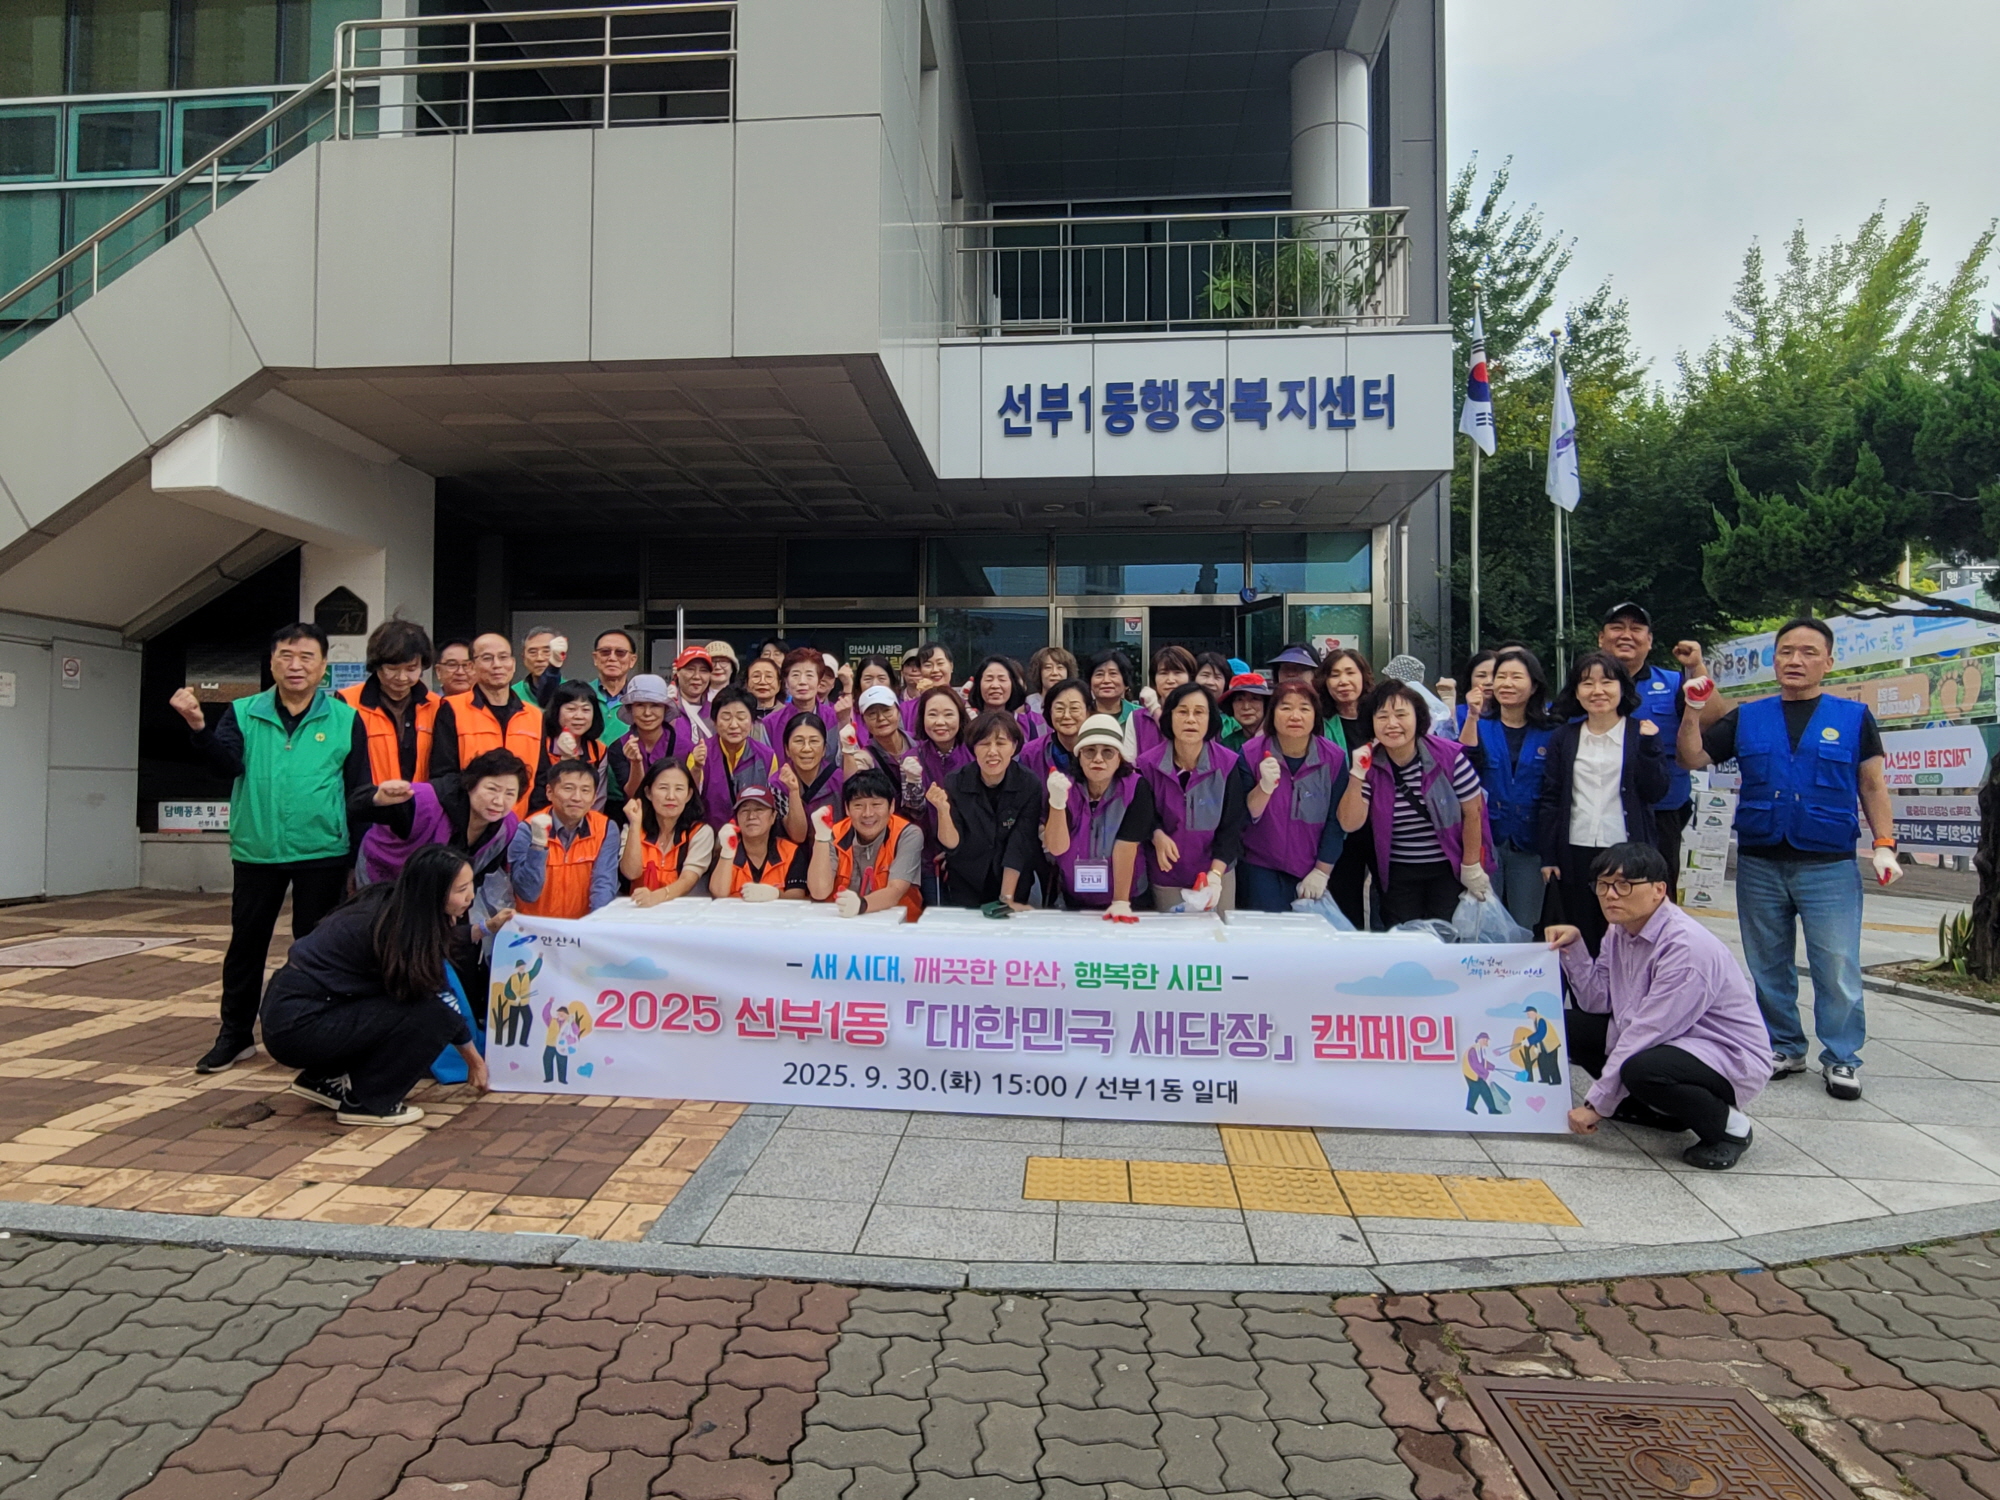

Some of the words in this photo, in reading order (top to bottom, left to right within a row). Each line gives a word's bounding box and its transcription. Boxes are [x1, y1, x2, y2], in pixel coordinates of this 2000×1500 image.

[998, 374, 1395, 437] 선부1동행정복지센터
[337, 612, 366, 632] 47
[207, 806, 217, 818] 및
[540, 935, 581, 948] 안산시
[810, 953, 837, 980] 새
[845, 954, 906, 985] 시대,
[913, 957, 998, 986] 깨끗한
[1004, 959, 1066, 990] 안산,
[1074, 961, 1159, 990] 행복한
[1166, 964, 1223, 992] 시민
[593, 988, 723, 1034] 2025
[734, 997, 889, 1046] 선부1동
[905, 999, 1115, 1054] 「대한민국
[1130, 1010, 1294, 1062] 새단장」
[1311, 1014, 1457, 1061] 캠페인
[782, 1061, 856, 1088] 2025.
[864, 1065, 887, 1090] 9.
[990, 1072, 1067, 1098] 15:00
[1095, 1076, 1184, 1103] 선부1동
[1192, 1079, 1239, 1105] 일대
